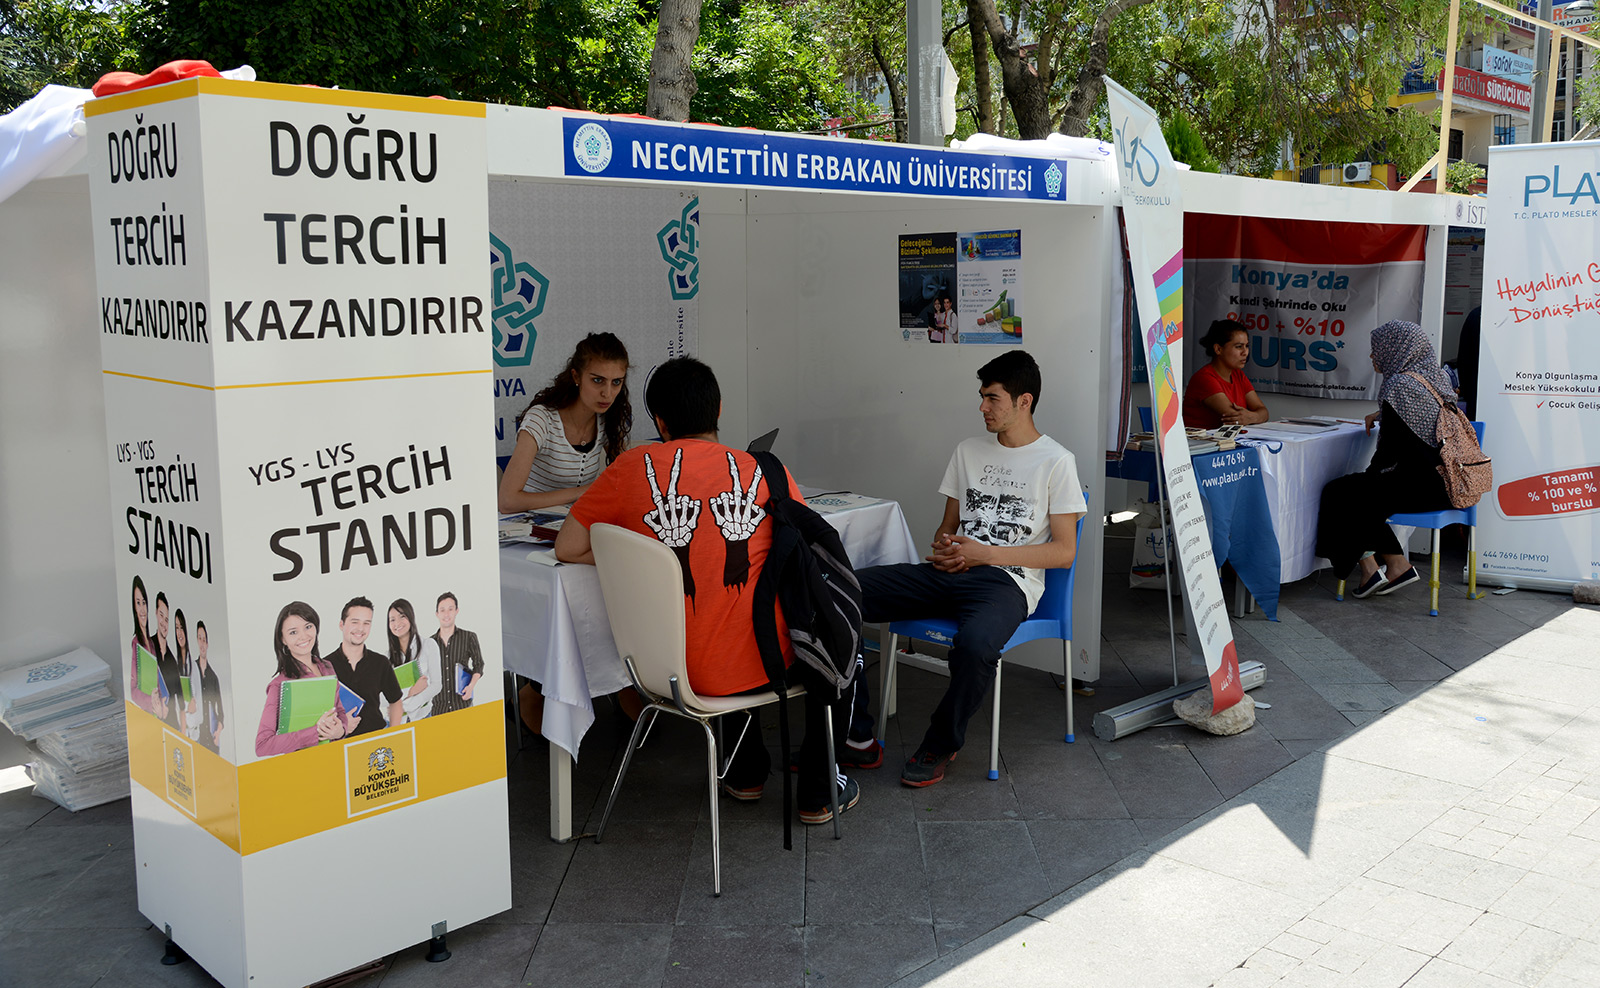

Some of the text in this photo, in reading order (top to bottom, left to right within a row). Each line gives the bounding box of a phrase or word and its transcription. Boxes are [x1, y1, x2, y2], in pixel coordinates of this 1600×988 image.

[1452, 73, 1486, 97] nadolu
[1486, 80, 1517, 104] SÜRÜCÜ
[108, 113, 178, 183] DOĞRU
[269, 113, 437, 183] DOĞRU
[631, 140, 1032, 192] NECMETTİN ERBAKAN ÜNİVERSİTESİ
[1524, 165, 1600, 207] PLA
[1467, 200, 1486, 224] İST
[1514, 209, 1598, 220] T.C. PLATO MESLEK
[111, 202, 187, 266] TERCİH
[264, 204, 447, 266] TERCİH
[1497, 272, 1583, 302] Hayalinin
[1229, 296, 1347, 312] Kendi Şehrinde Oku
[101, 297, 209, 345] KAZANDIRIR
[225, 295, 485, 342] KAZANDIRIR
[1293, 317, 1346, 337] %10
[1504, 383, 1596, 393] Meslek Yüksekokulu
[1515, 371, 1598, 382] Konya Olgunlaşma
[1548, 400, 1576, 409] Çocuk
[116, 443, 130, 463] LYS
[136, 440, 155, 460] YGS
[1212, 456, 1226, 469] 444
[248, 458, 296, 486] YGS
[317, 442, 356, 469] LYS
[135, 454, 200, 504] TERCİH
[300, 444, 452, 517] TERCİH
[1542, 471, 1594, 486] Tamamı
[1542, 487, 1565, 500] 100
[1567, 487, 1582, 496] ve
[1551, 498, 1593, 512] burslu
[127, 506, 213, 584] STANDI
[269, 504, 472, 581] STANDI
[1499, 552, 1518, 560] 7696
[354, 773, 410, 797] BÜYÜKŞEHİR
[368, 769, 396, 783] KONYA
[366, 786, 399, 801] BELEDİYESİ
